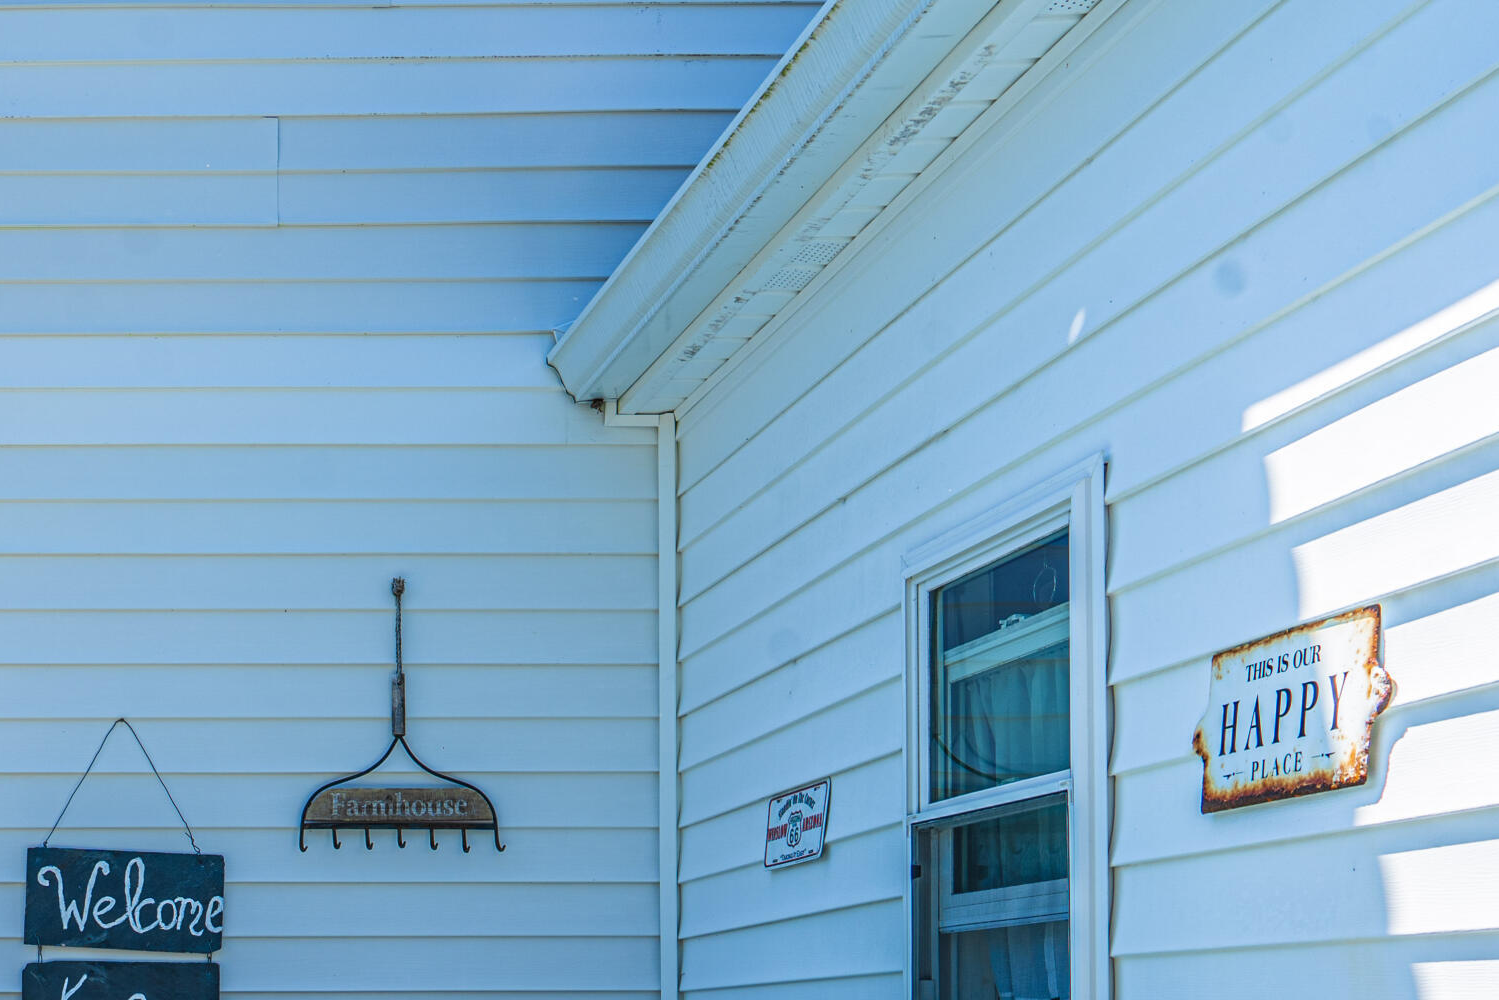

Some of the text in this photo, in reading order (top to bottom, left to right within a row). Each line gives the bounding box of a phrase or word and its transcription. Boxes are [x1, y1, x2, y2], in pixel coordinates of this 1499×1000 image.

[1245, 644, 1321, 682] THIS IS OUR
[1218, 671, 1350, 757] HAPPY
[1251, 751, 1303, 781] PLACE
[330, 791, 468, 817] Farmhouse
[790, 827, 799, 843] 66
[37, 857, 224, 936] Welcome
